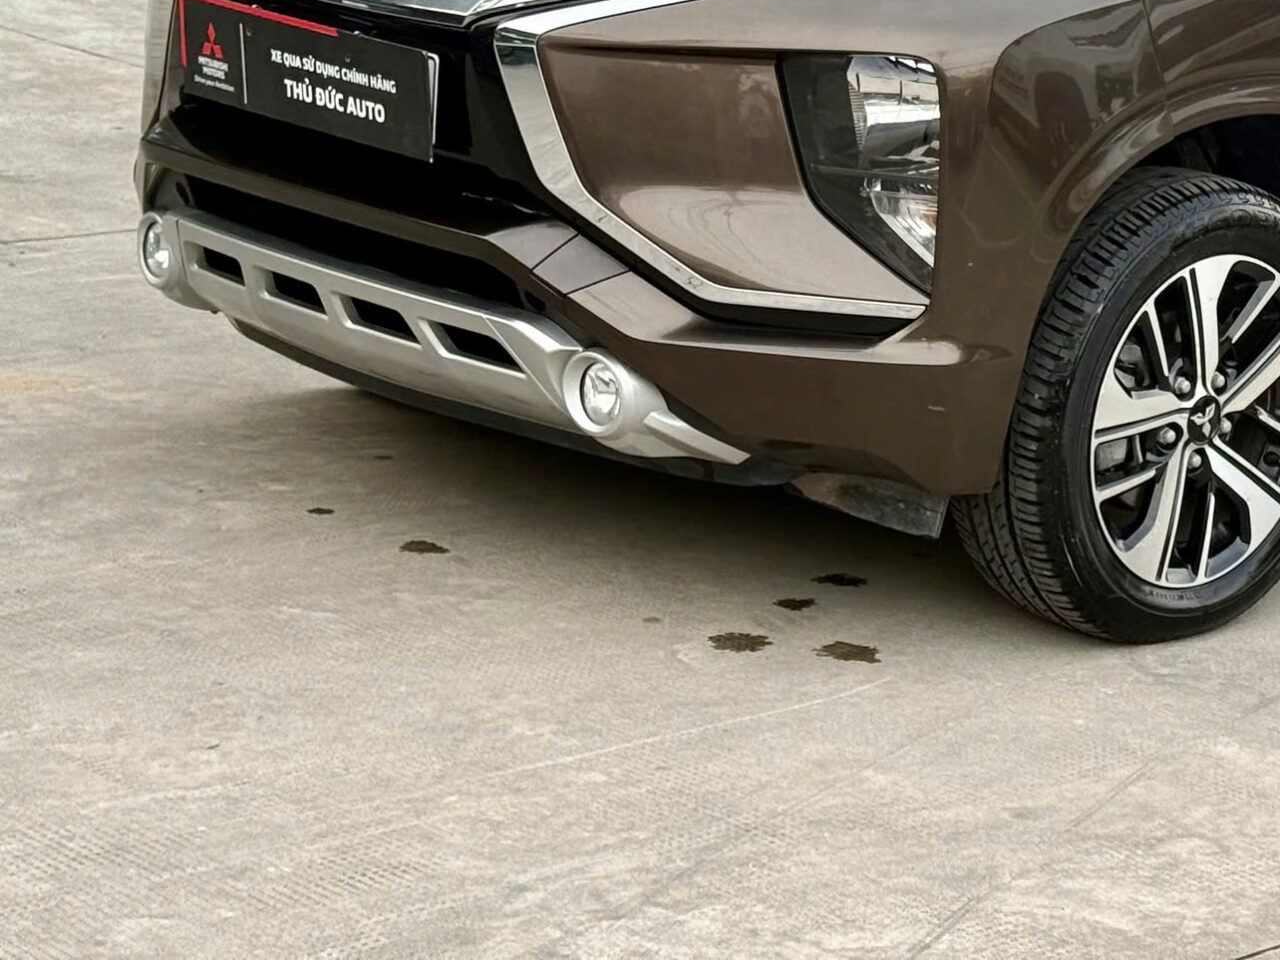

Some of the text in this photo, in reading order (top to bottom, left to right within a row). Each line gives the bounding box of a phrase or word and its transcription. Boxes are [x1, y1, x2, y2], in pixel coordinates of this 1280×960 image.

[270, 48, 397, 94] XE QUA SỬ DỤNG CHÍNH HÃNG
[284, 77, 385, 123] THỦ ĐỨC AUTO
